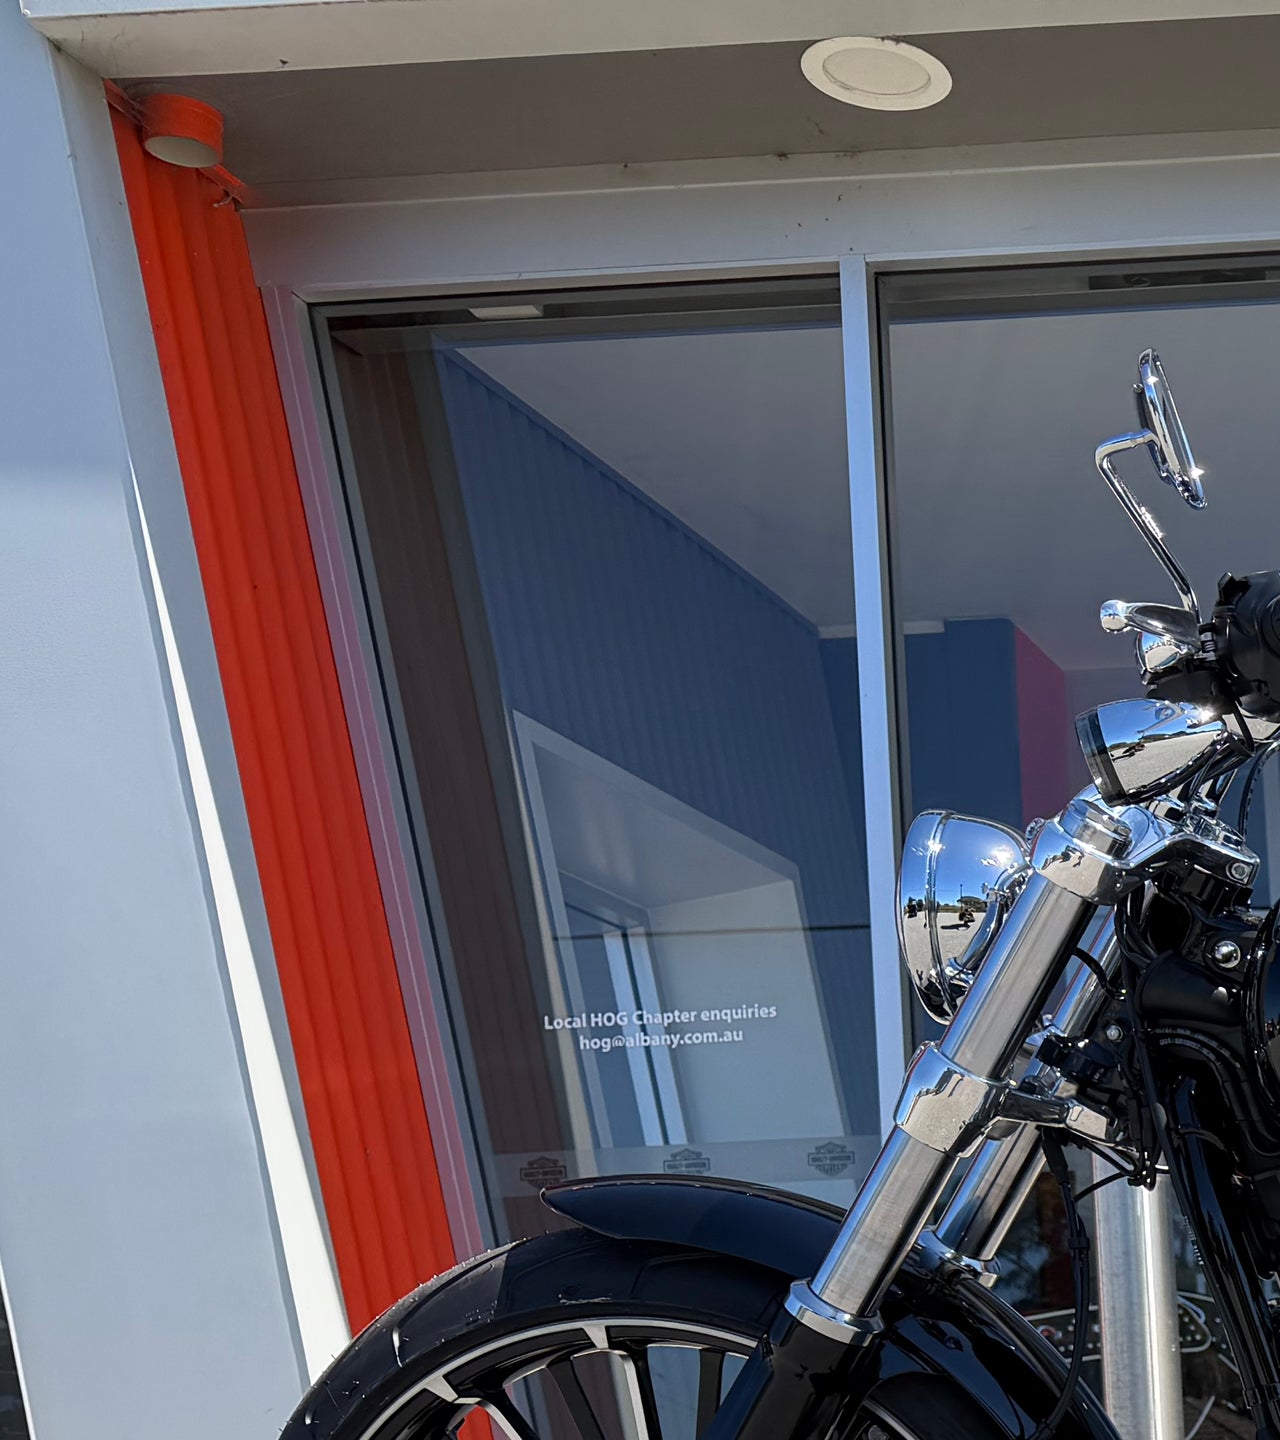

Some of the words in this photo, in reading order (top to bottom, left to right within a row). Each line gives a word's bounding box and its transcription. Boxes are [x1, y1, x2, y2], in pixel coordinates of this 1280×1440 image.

[544, 1013, 588, 1031] Local
[590, 1011, 629, 1028] HOG
[632, 1008, 697, 1028] Chapter
[700, 1003, 778, 1025] enquiries
[579, 1027, 745, 1053] hog@albany.com.au
